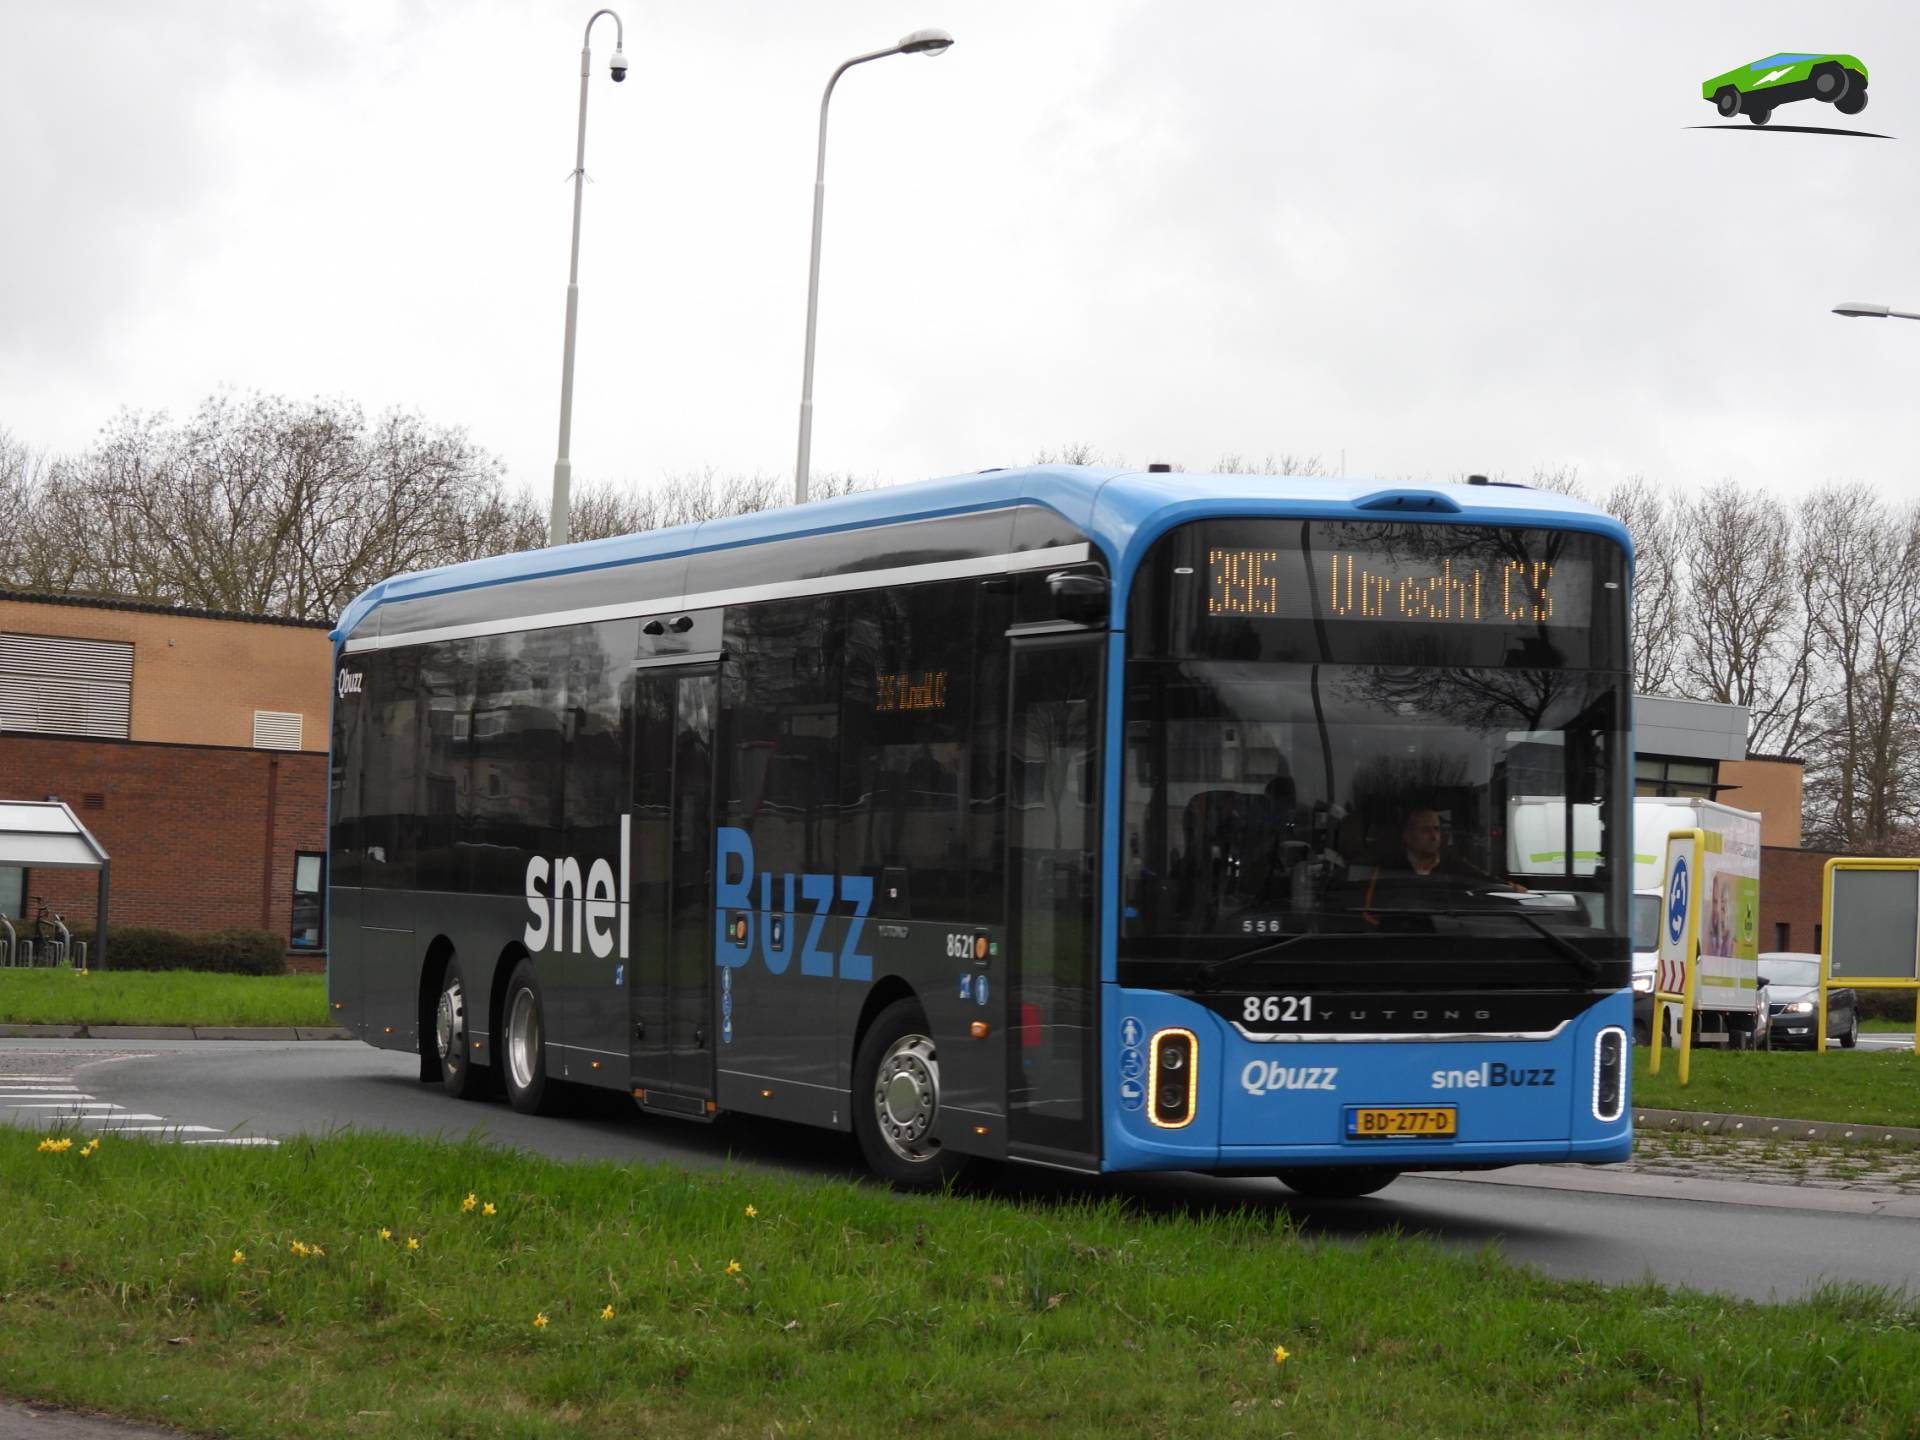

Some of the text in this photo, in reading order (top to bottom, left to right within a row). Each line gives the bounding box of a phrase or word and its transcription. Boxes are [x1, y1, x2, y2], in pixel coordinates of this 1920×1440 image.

[1209, 550, 1553, 621] 395 Utrecht CS
[338, 668, 363, 699] Qbuzz
[523, 813, 874, 982] snel Buzz
[946, 933, 975, 959] 8621
[1243, 995, 1491, 1023] 8621 YUTONG
[1241, 1059, 1339, 1096] Qbuzz
[1431, 1061, 1557, 1090] snelBuzz
[1363, 1112, 1449, 1131] BD-277-D
